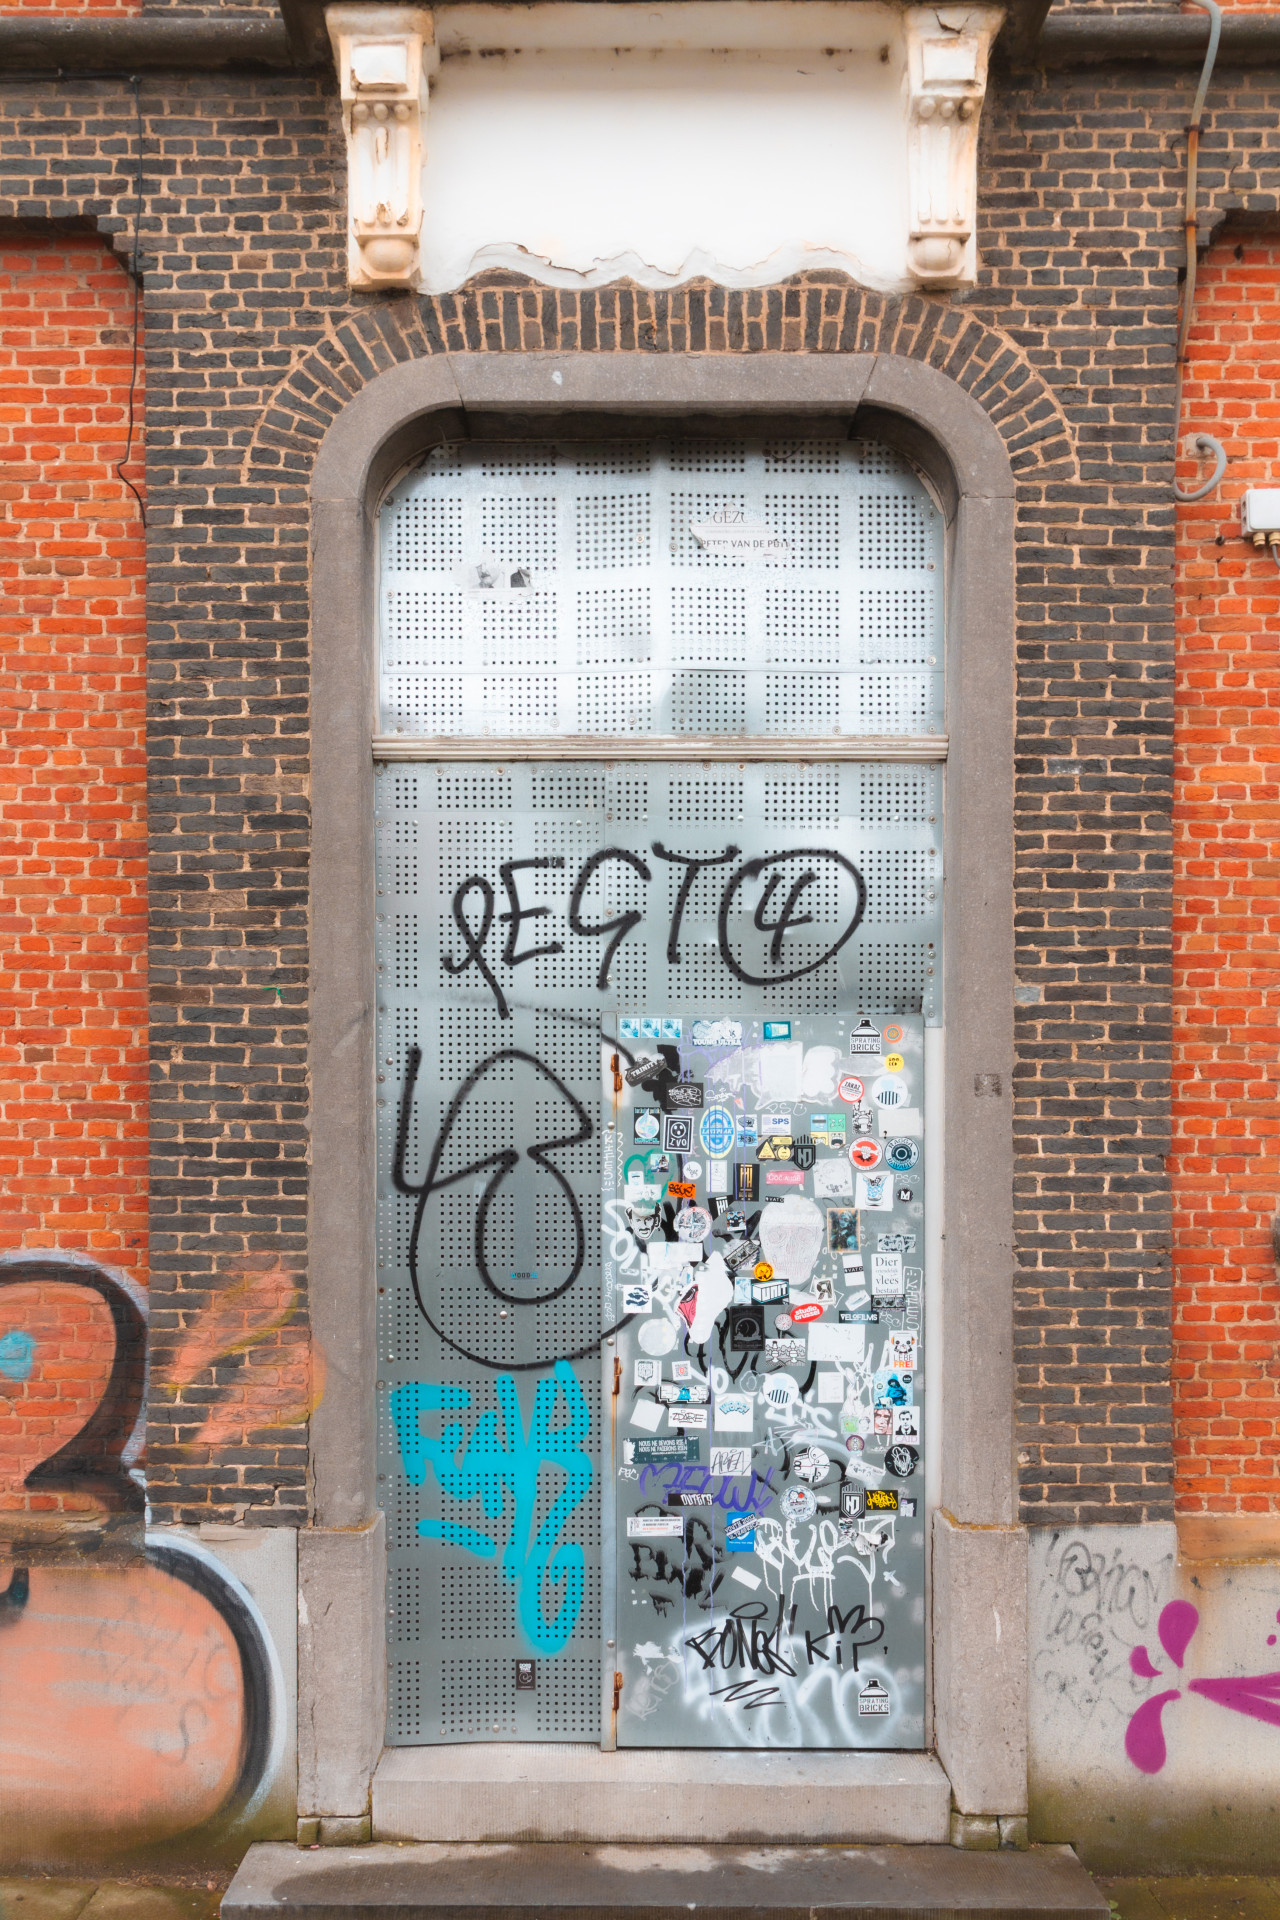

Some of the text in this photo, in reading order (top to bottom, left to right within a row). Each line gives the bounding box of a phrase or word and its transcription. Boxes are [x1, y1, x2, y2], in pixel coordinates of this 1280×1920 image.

[850, 1043, 881, 1051] BRICKS
[630, 1060, 658, 1077] TRINITY
[771, 1117, 790, 1125] SPS
[875, 1257, 898, 1267] Dier
[876, 1275, 899, 1285] vlees
[859, 1704, 889, 1712] BRICKS
